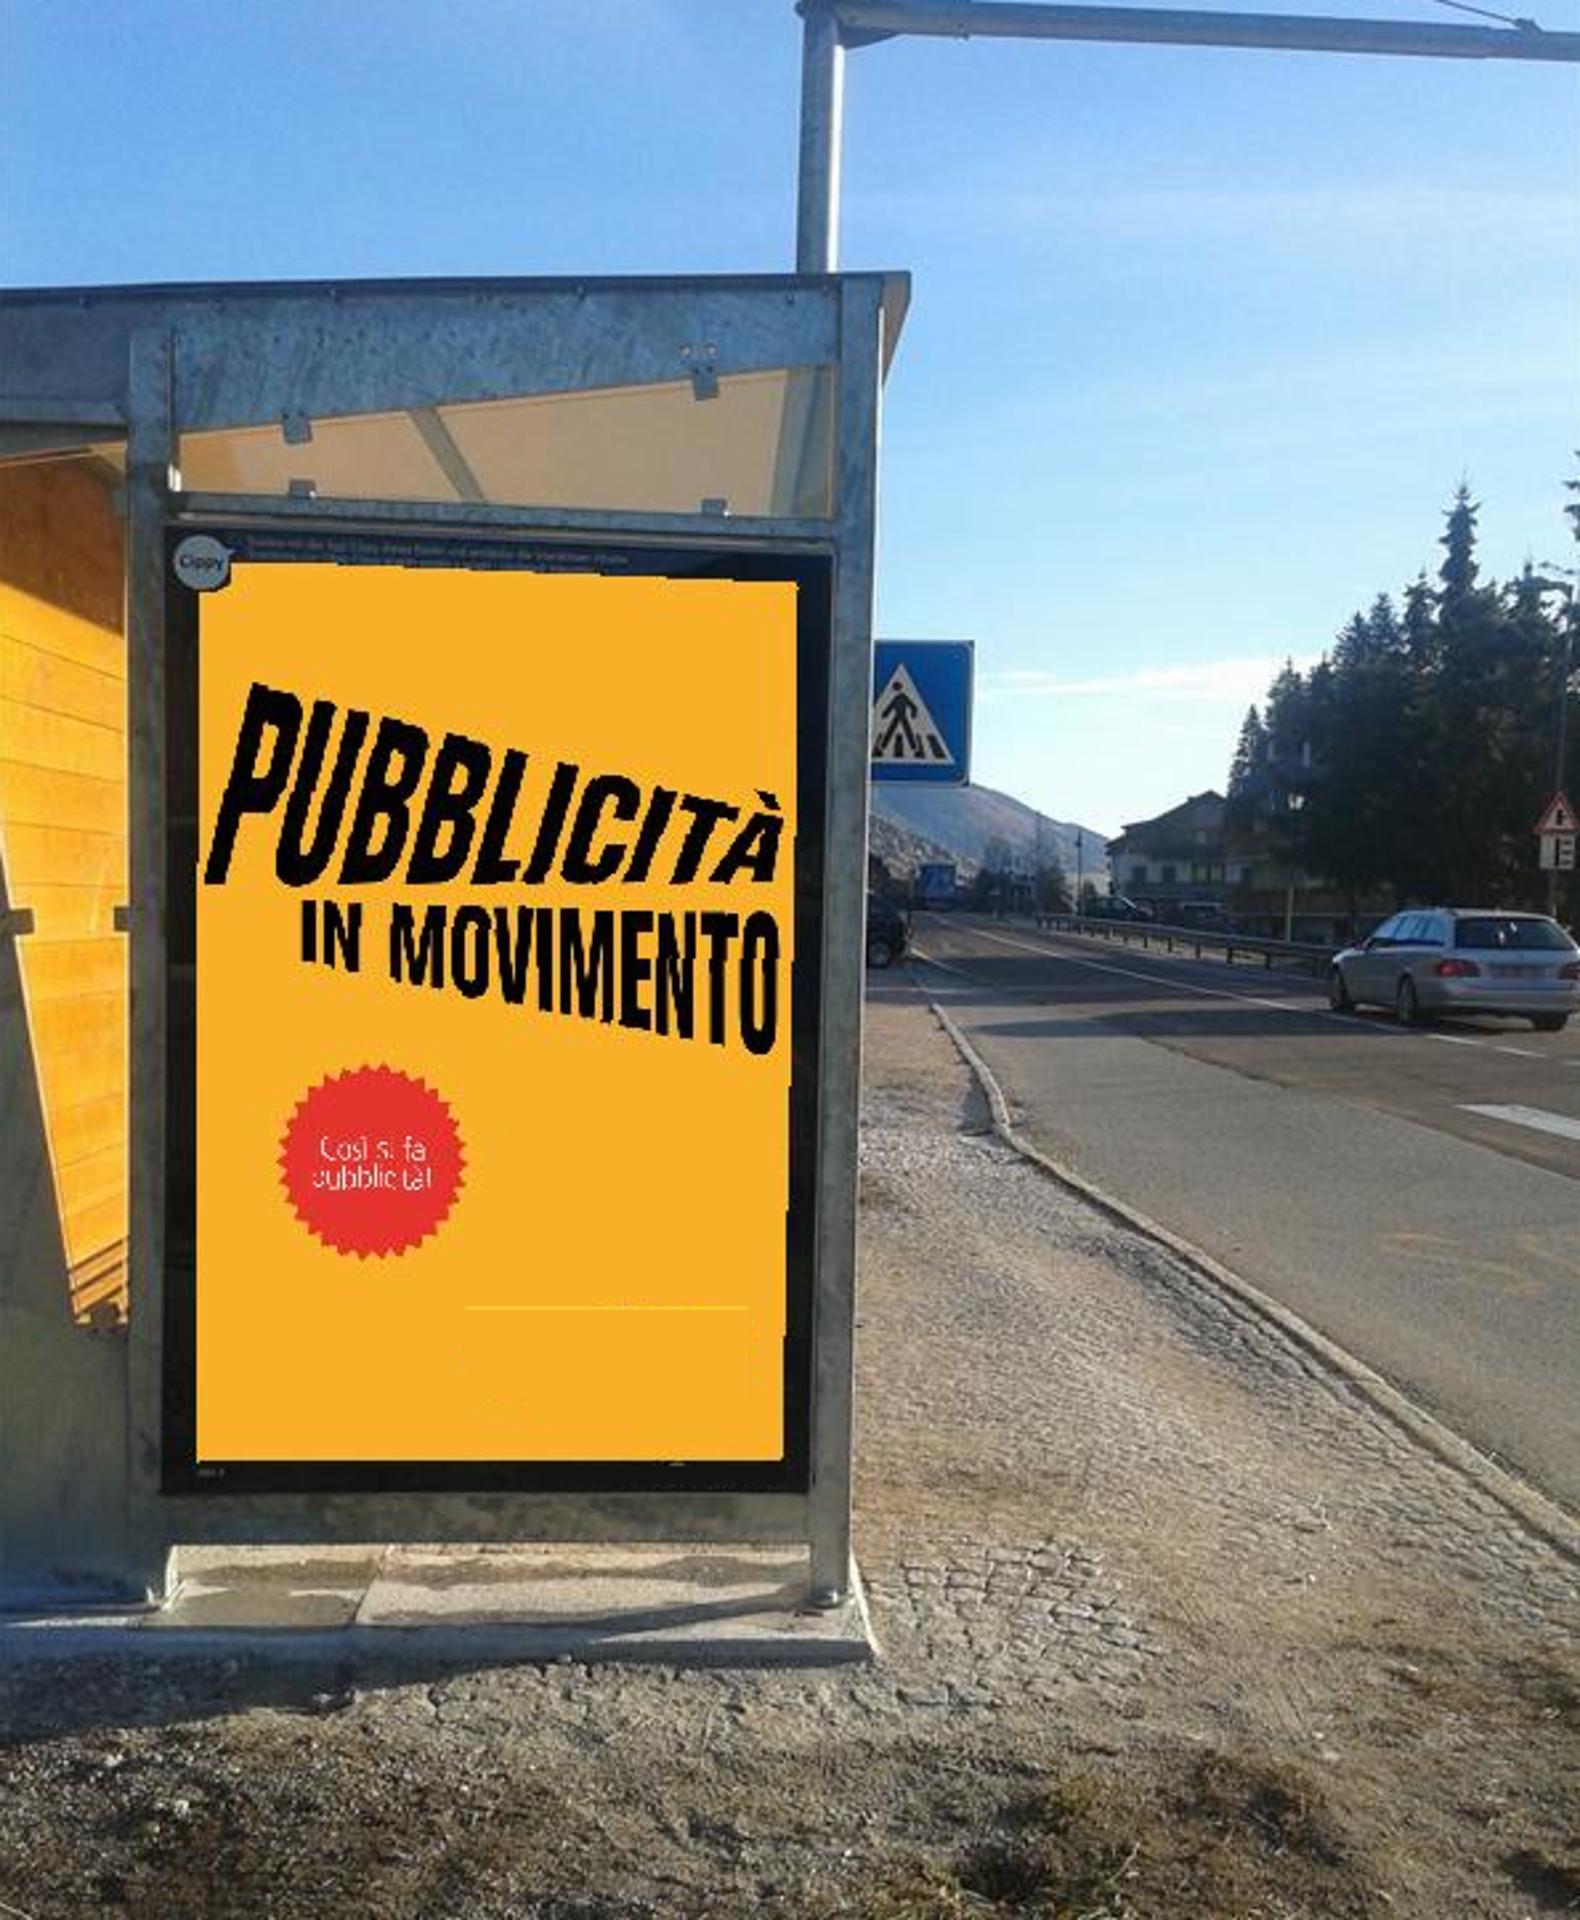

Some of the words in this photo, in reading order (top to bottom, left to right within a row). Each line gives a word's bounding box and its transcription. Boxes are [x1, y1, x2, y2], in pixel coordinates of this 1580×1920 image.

[203, 682, 785, 888] PUBBLICITÀ
[302, 900, 363, 972] IN
[389, 902, 780, 1055] MOVIMENTO
[376, 1141, 395, 1160] s
[404, 1135, 427, 1162] fa
